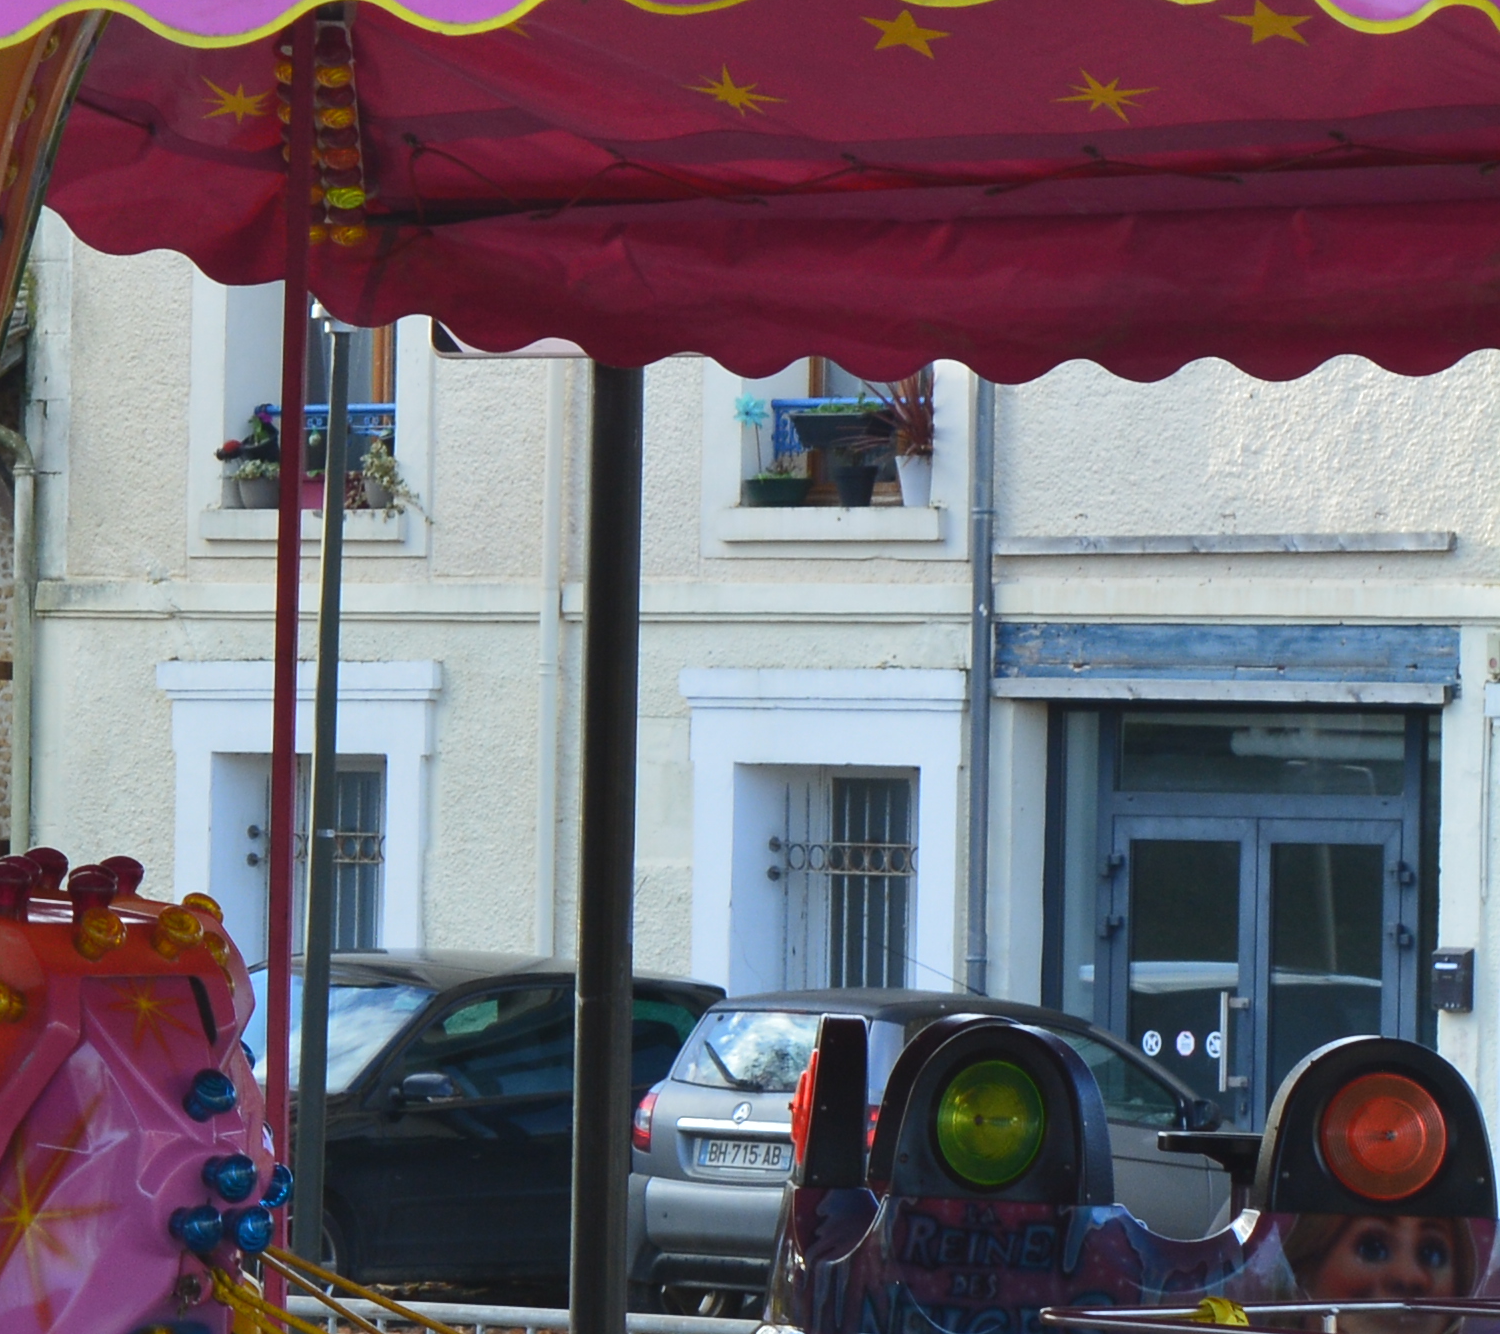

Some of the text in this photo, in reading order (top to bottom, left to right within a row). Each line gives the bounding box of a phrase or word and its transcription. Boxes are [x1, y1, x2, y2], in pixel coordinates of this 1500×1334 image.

[966, 1204, 998, 1226] LA
[904, 1213, 1057, 1269] REINE
[951, 1273, 998, 1300] DES
